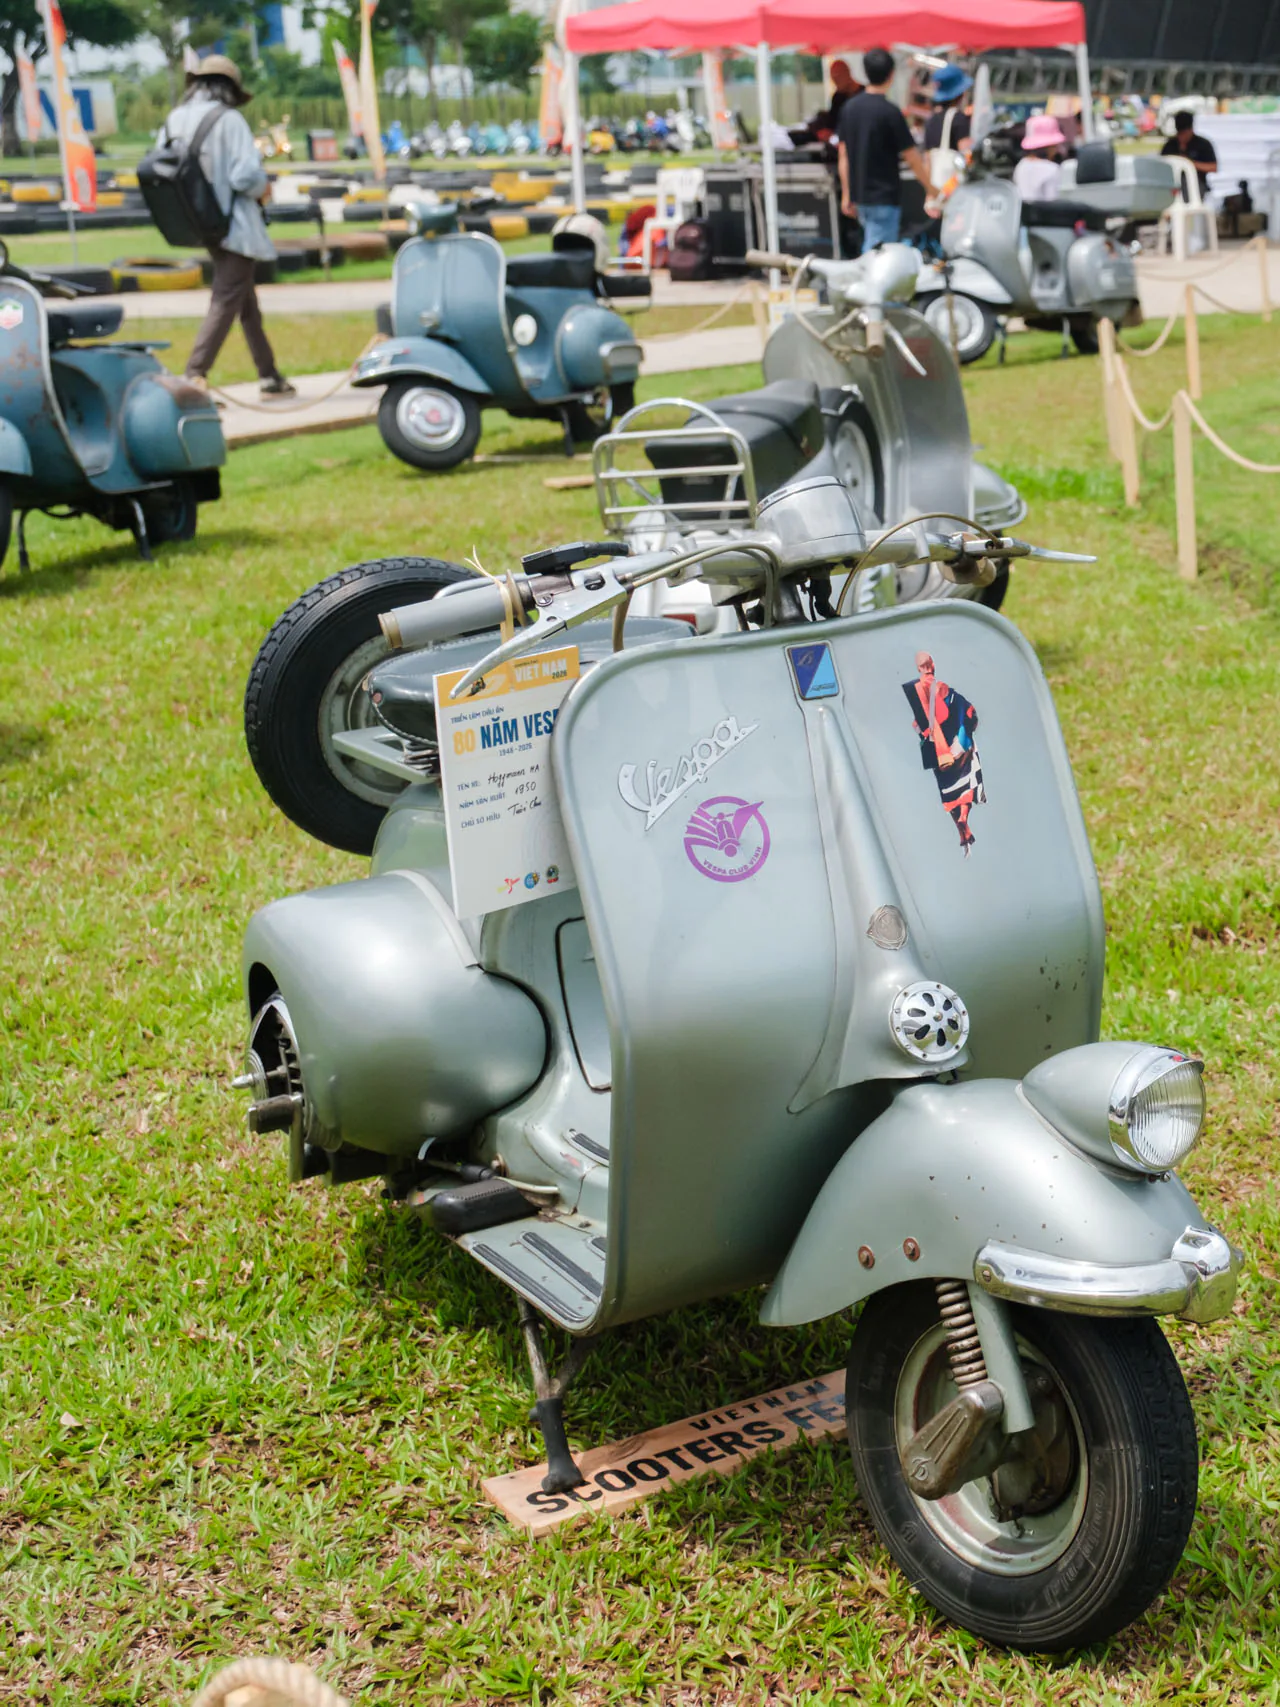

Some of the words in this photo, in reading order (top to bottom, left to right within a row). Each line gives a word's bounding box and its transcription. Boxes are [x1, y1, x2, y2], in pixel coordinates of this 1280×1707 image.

[453, 728, 476, 755] 80
[480, 716, 519, 749] NĂM
[514, 781, 537, 796] 1950
[617, 715, 761, 832] Vespa
[703, 858, 727, 876] VESPA
[728, 864, 749, 875] CLUB
[689, 1380, 829, 1431] VIETNAM
